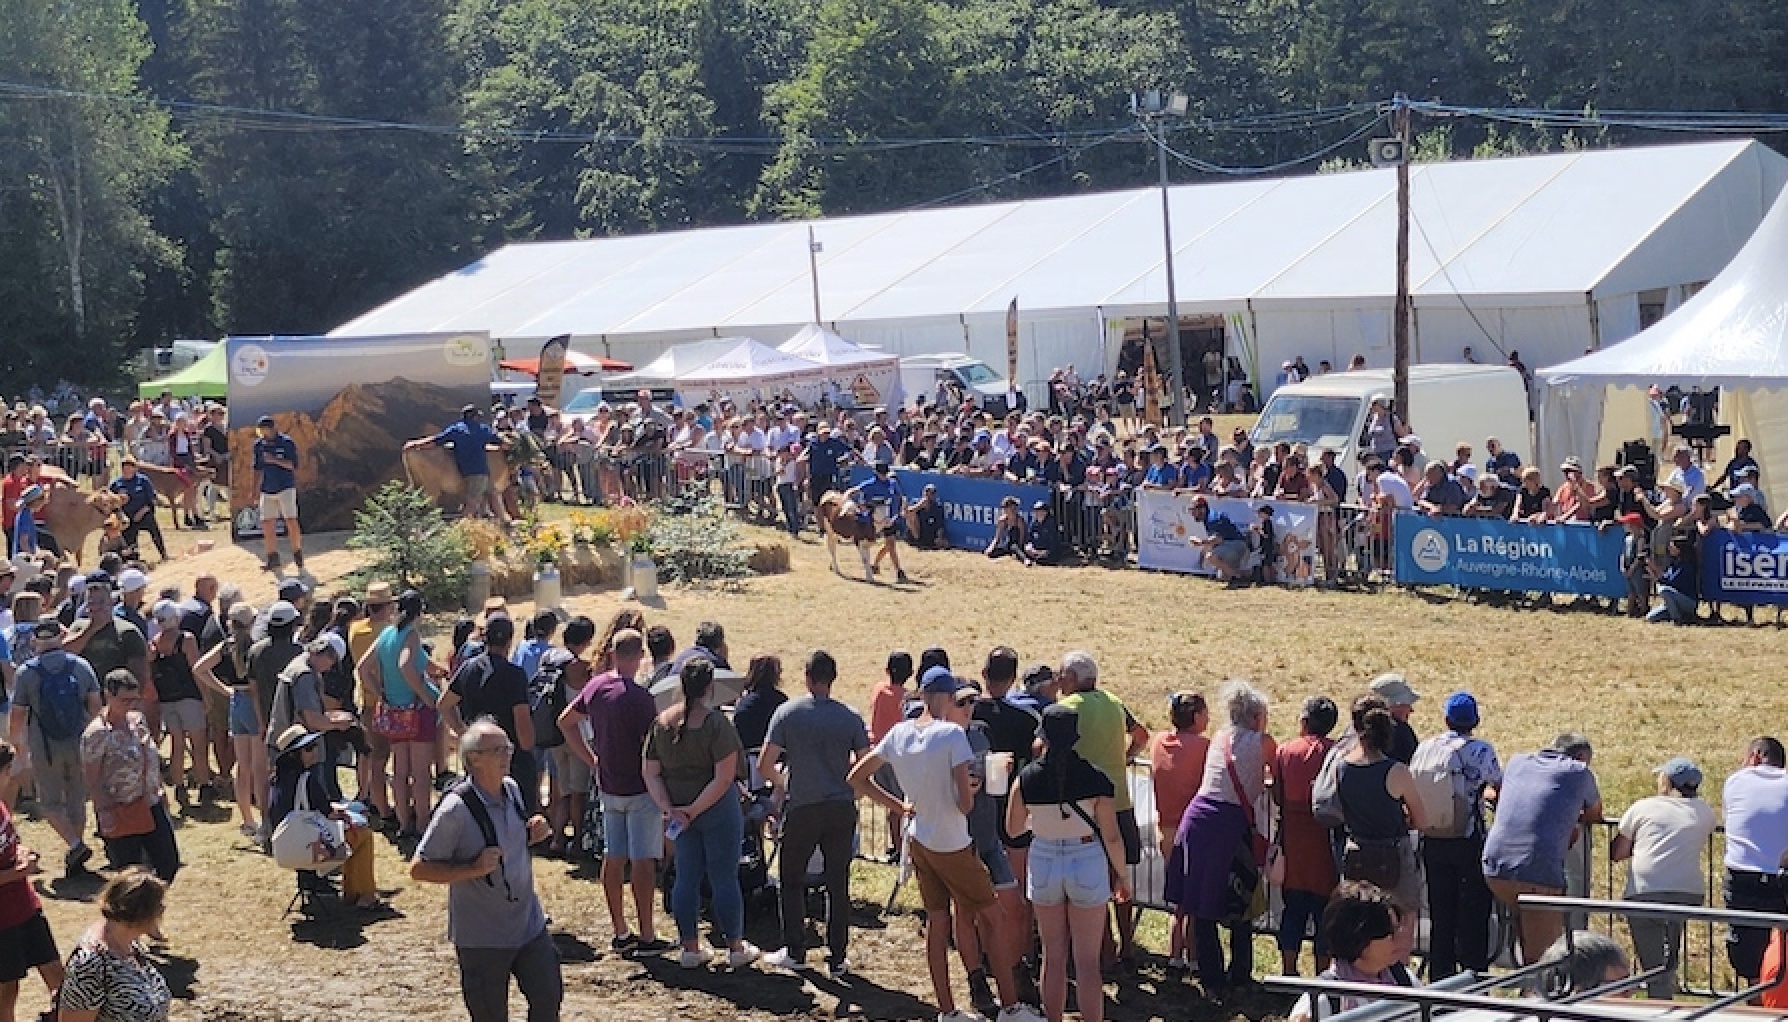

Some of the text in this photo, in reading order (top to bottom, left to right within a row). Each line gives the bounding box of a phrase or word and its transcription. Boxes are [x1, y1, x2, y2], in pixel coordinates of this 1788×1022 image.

[1456, 534, 1553, 561] La Région
[1725, 542, 1788, 578] isèr
[1456, 558, 1607, 583] Auvergne-Rhône-Alpes
[1737, 580, 1788, 589] DÉPARTE
